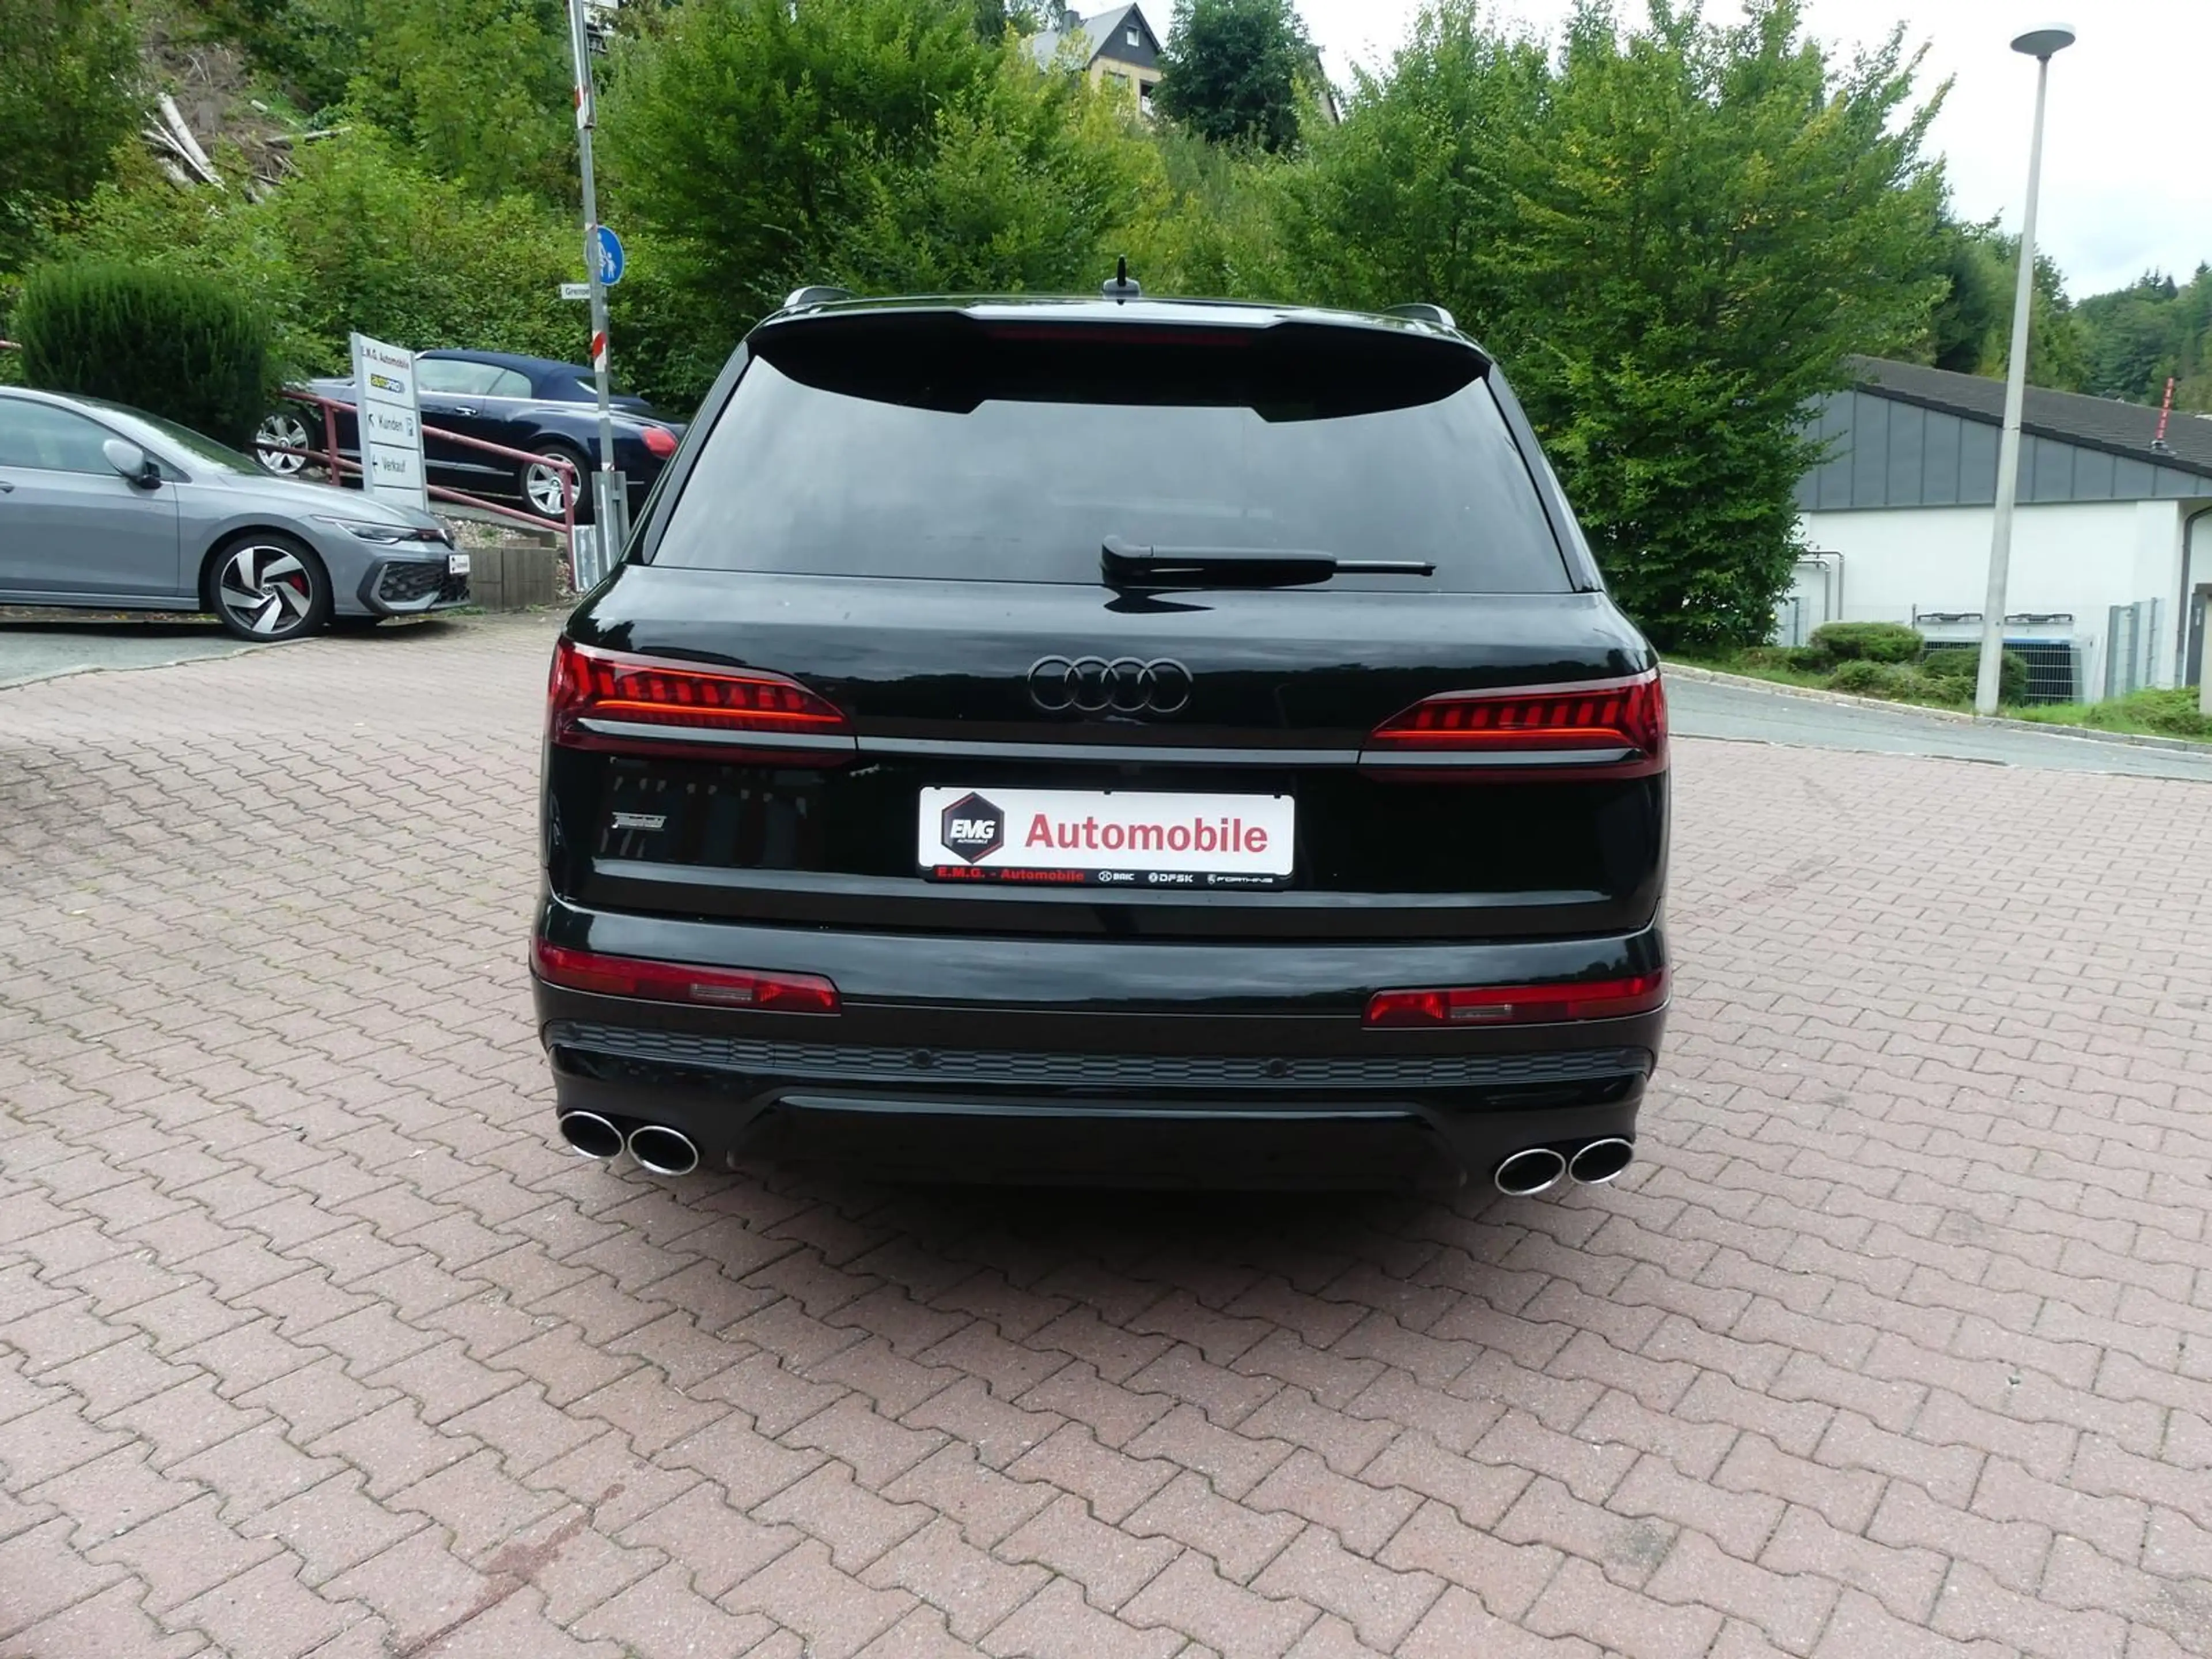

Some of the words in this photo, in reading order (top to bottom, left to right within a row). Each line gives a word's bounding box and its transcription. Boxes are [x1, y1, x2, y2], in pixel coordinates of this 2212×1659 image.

[378, 414, 403, 431] Kunden
[381, 456, 406, 472] Verkauf
[950, 819, 996, 838] EMG
[1025, 814, 1268, 852] Automobile
[938, 867, 985, 878] E.M.G.
[1001, 869, 1084, 881] Automobile
[1159, 873, 1194, 883] DFSK
